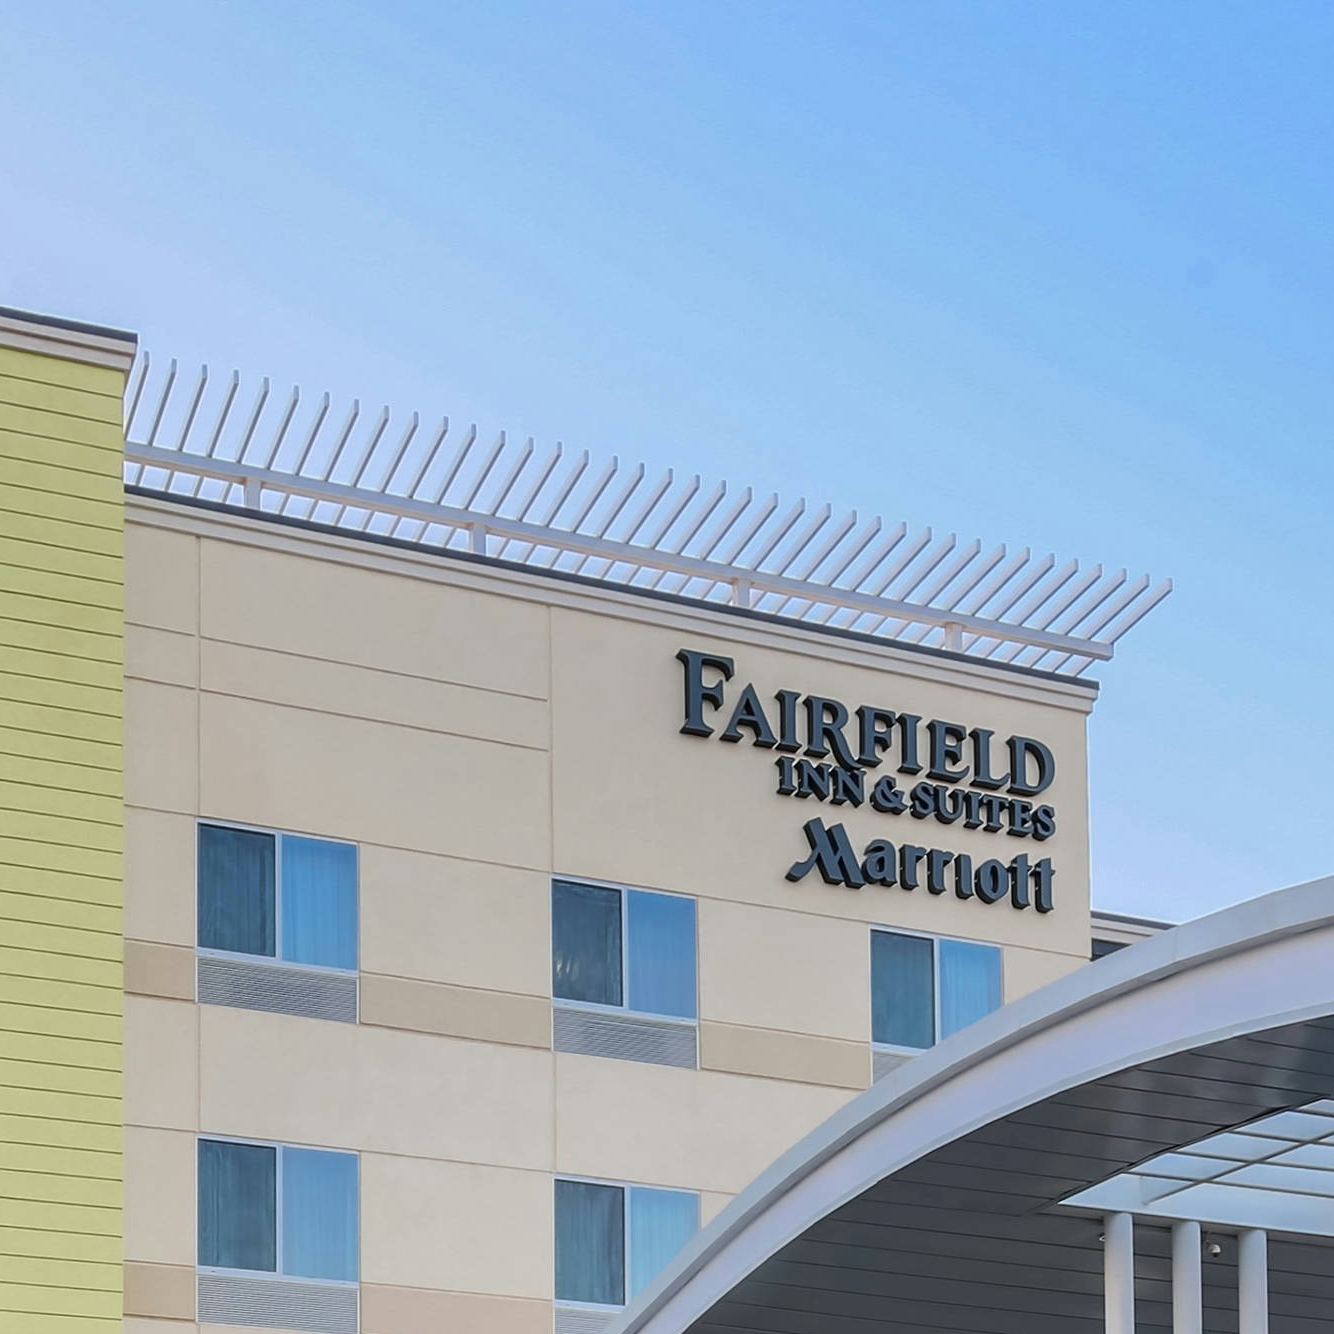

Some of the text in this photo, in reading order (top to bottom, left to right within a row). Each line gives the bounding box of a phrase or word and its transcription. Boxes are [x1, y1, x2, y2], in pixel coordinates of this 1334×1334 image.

[675, 648, 1056, 797] FAIRFIELD
[776, 756, 1056, 841] INN & SUITES
[785, 817, 1055, 913] Marriott
